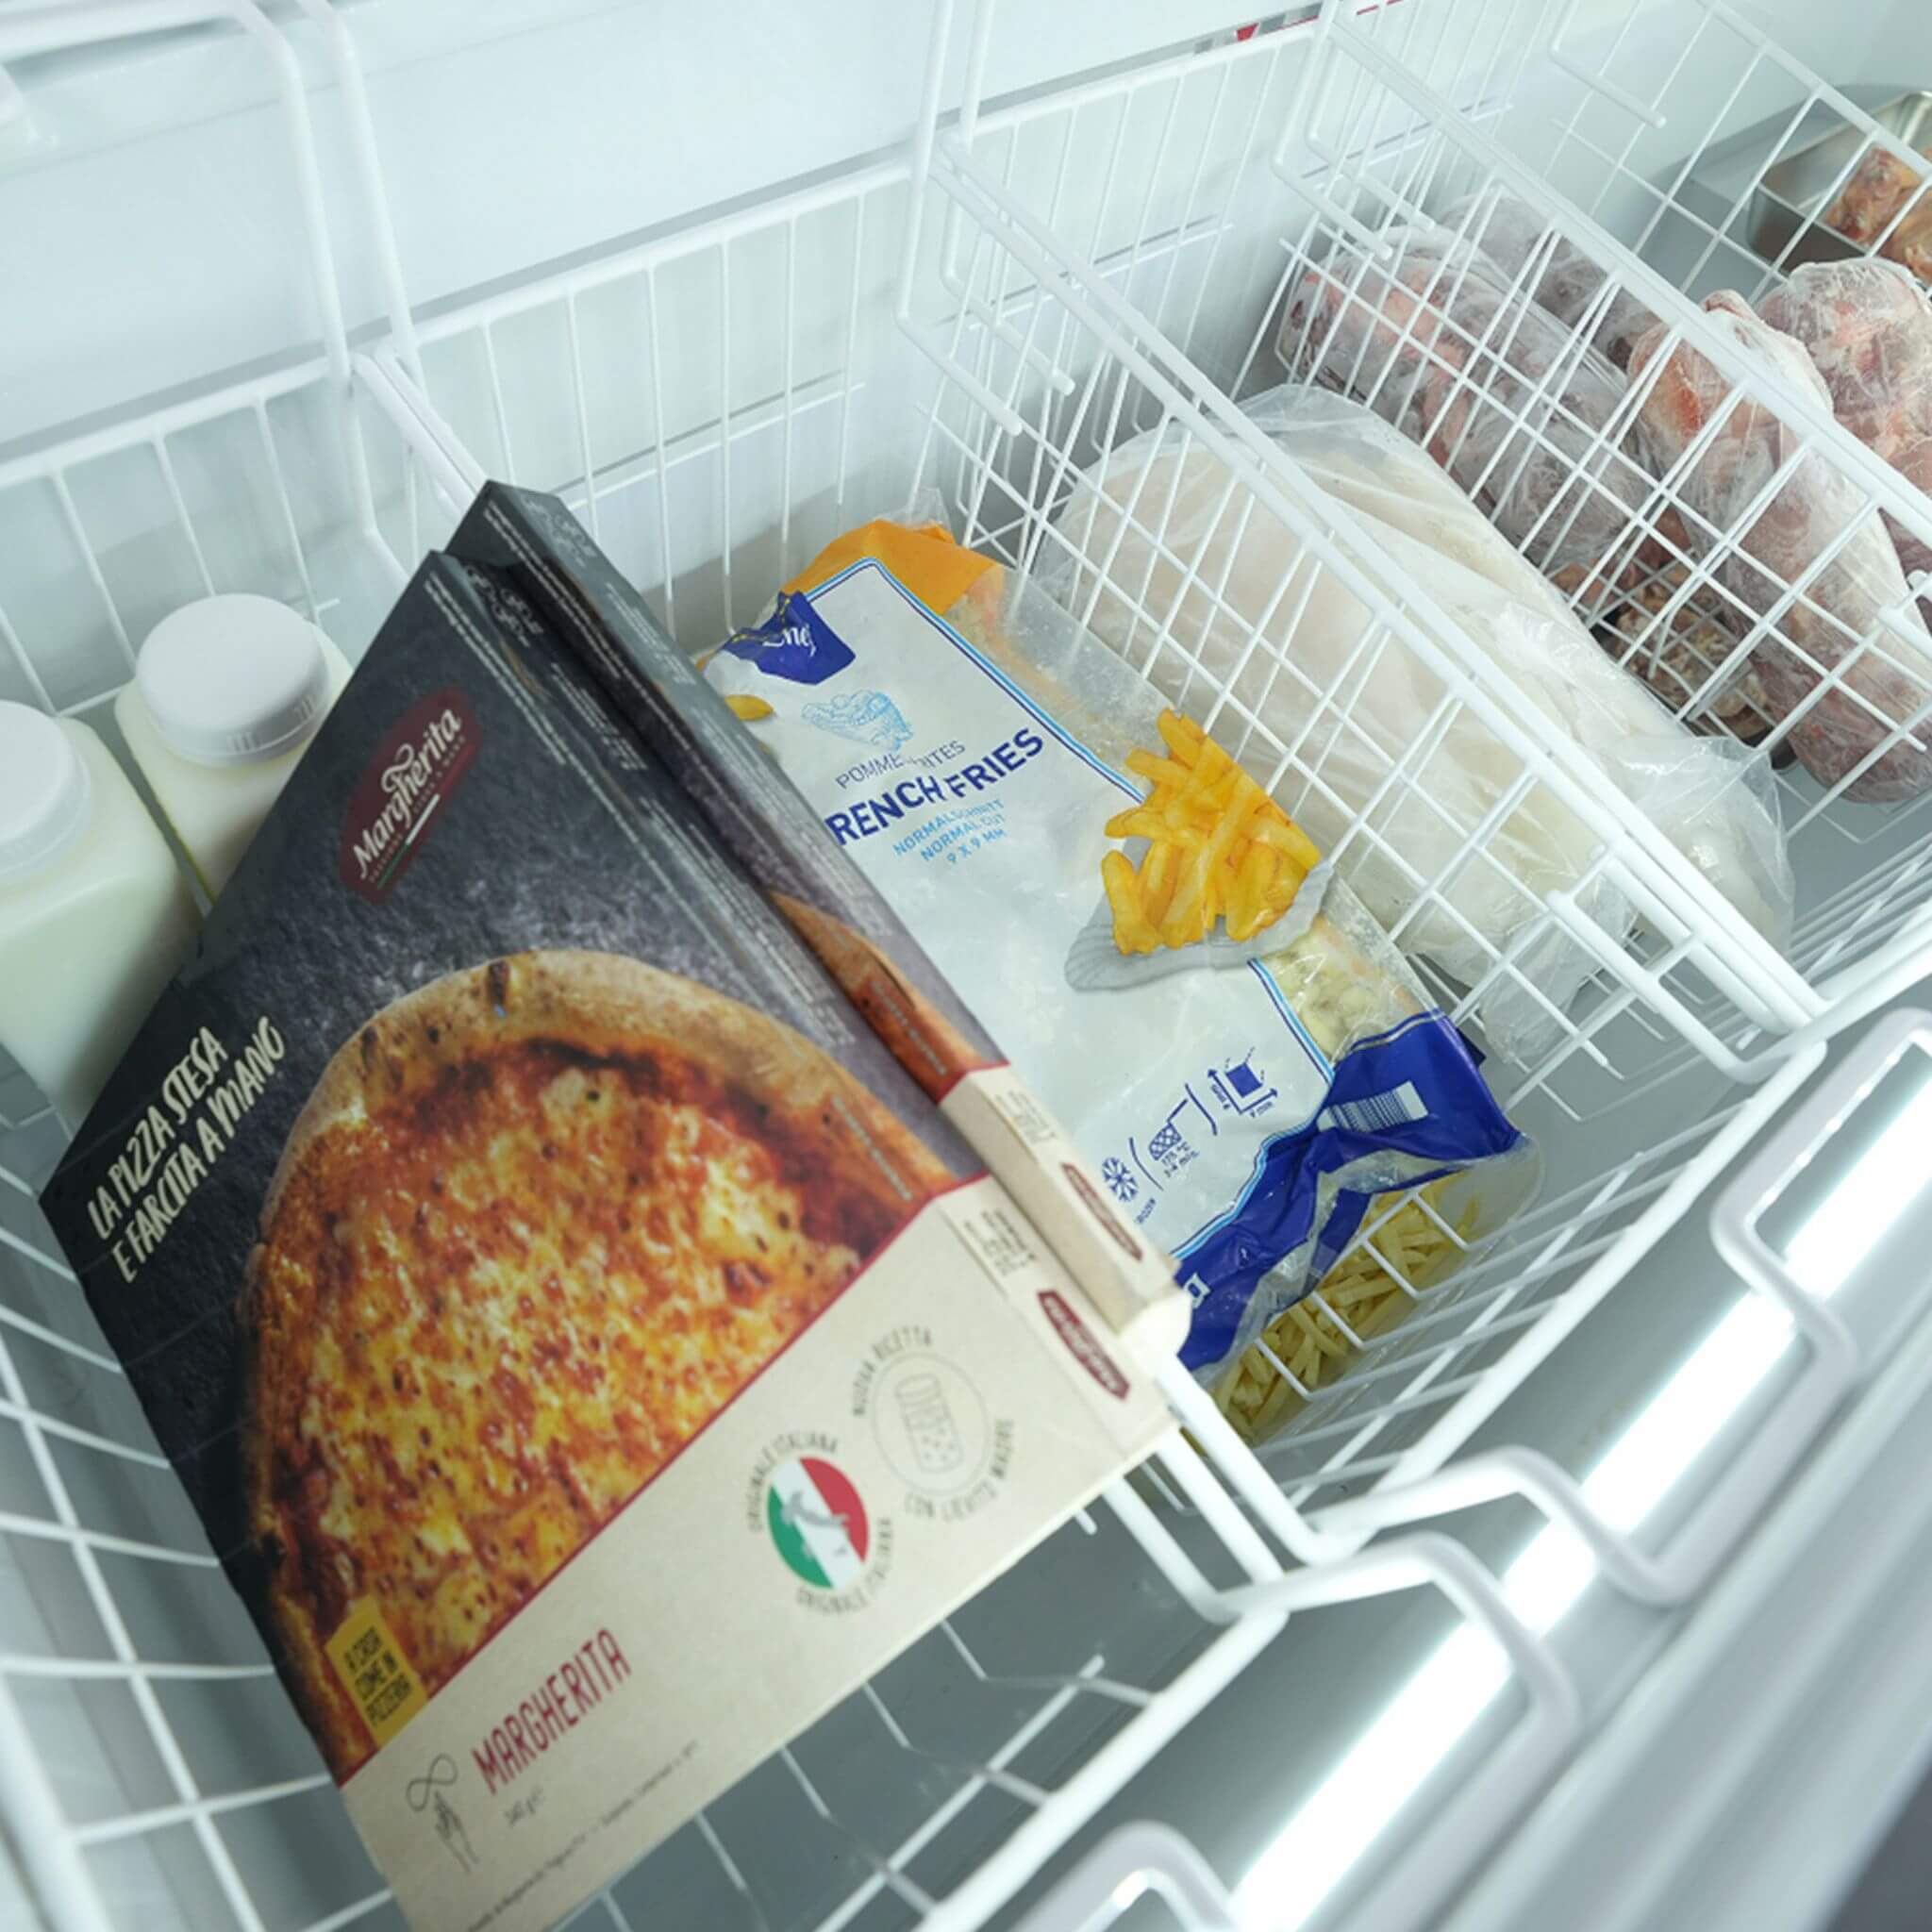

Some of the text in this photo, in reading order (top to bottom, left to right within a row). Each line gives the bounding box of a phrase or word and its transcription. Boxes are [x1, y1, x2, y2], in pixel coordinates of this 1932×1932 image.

[353, 708, 462, 880] Margherita
[824, 727, 1044, 846] RENCH FRIES
[920, 820, 982, 862] NORMAL
[946, 851, 958, 865] 9
[972, 836, 982, 850] 9
[87, 1025, 229, 1241] LA PIZZA STESA
[111, 1016, 286, 1284] E FARCITA A MANO
[471, 1628, 633, 1797] MARGHERITA
